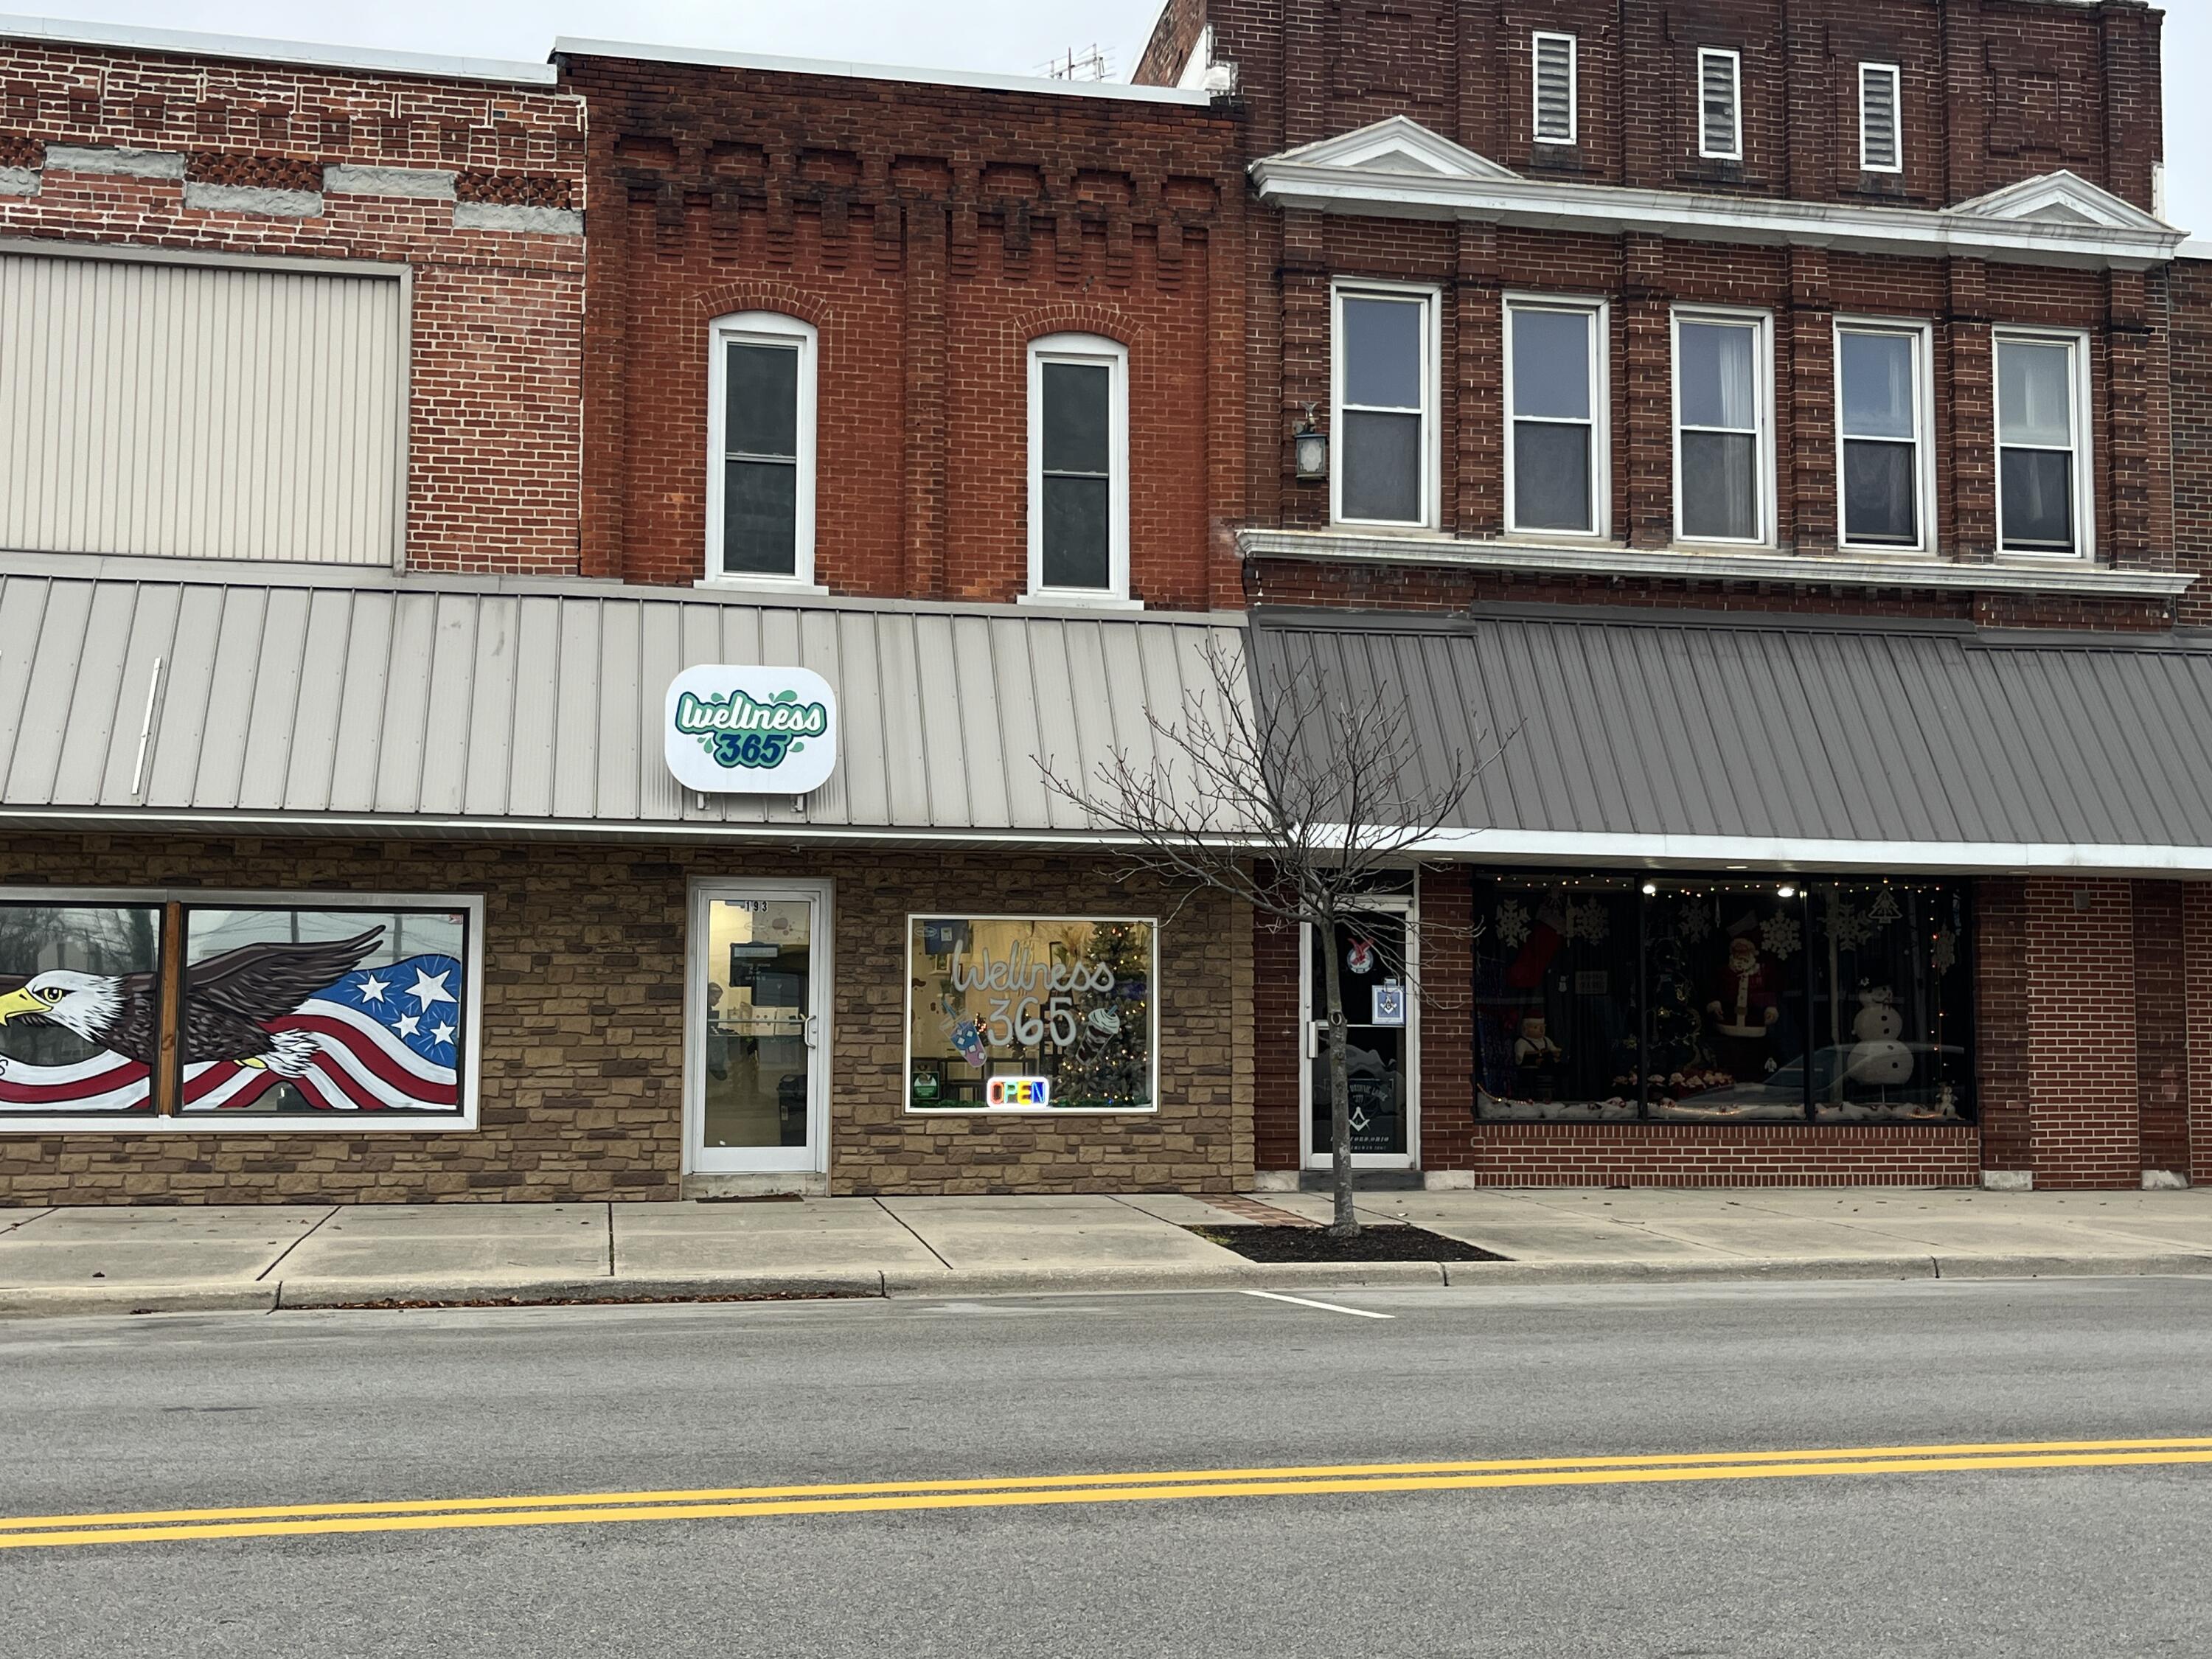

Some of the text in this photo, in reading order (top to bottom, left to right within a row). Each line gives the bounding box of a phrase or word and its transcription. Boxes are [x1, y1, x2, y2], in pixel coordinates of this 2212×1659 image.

[719, 733, 788, 763] 365
[746, 900, 768, 912] 193
[951, 939, 1116, 992] Wellness
[987, 996, 1077, 1047] 365
[990, 1080, 1046, 1105] OPEN
